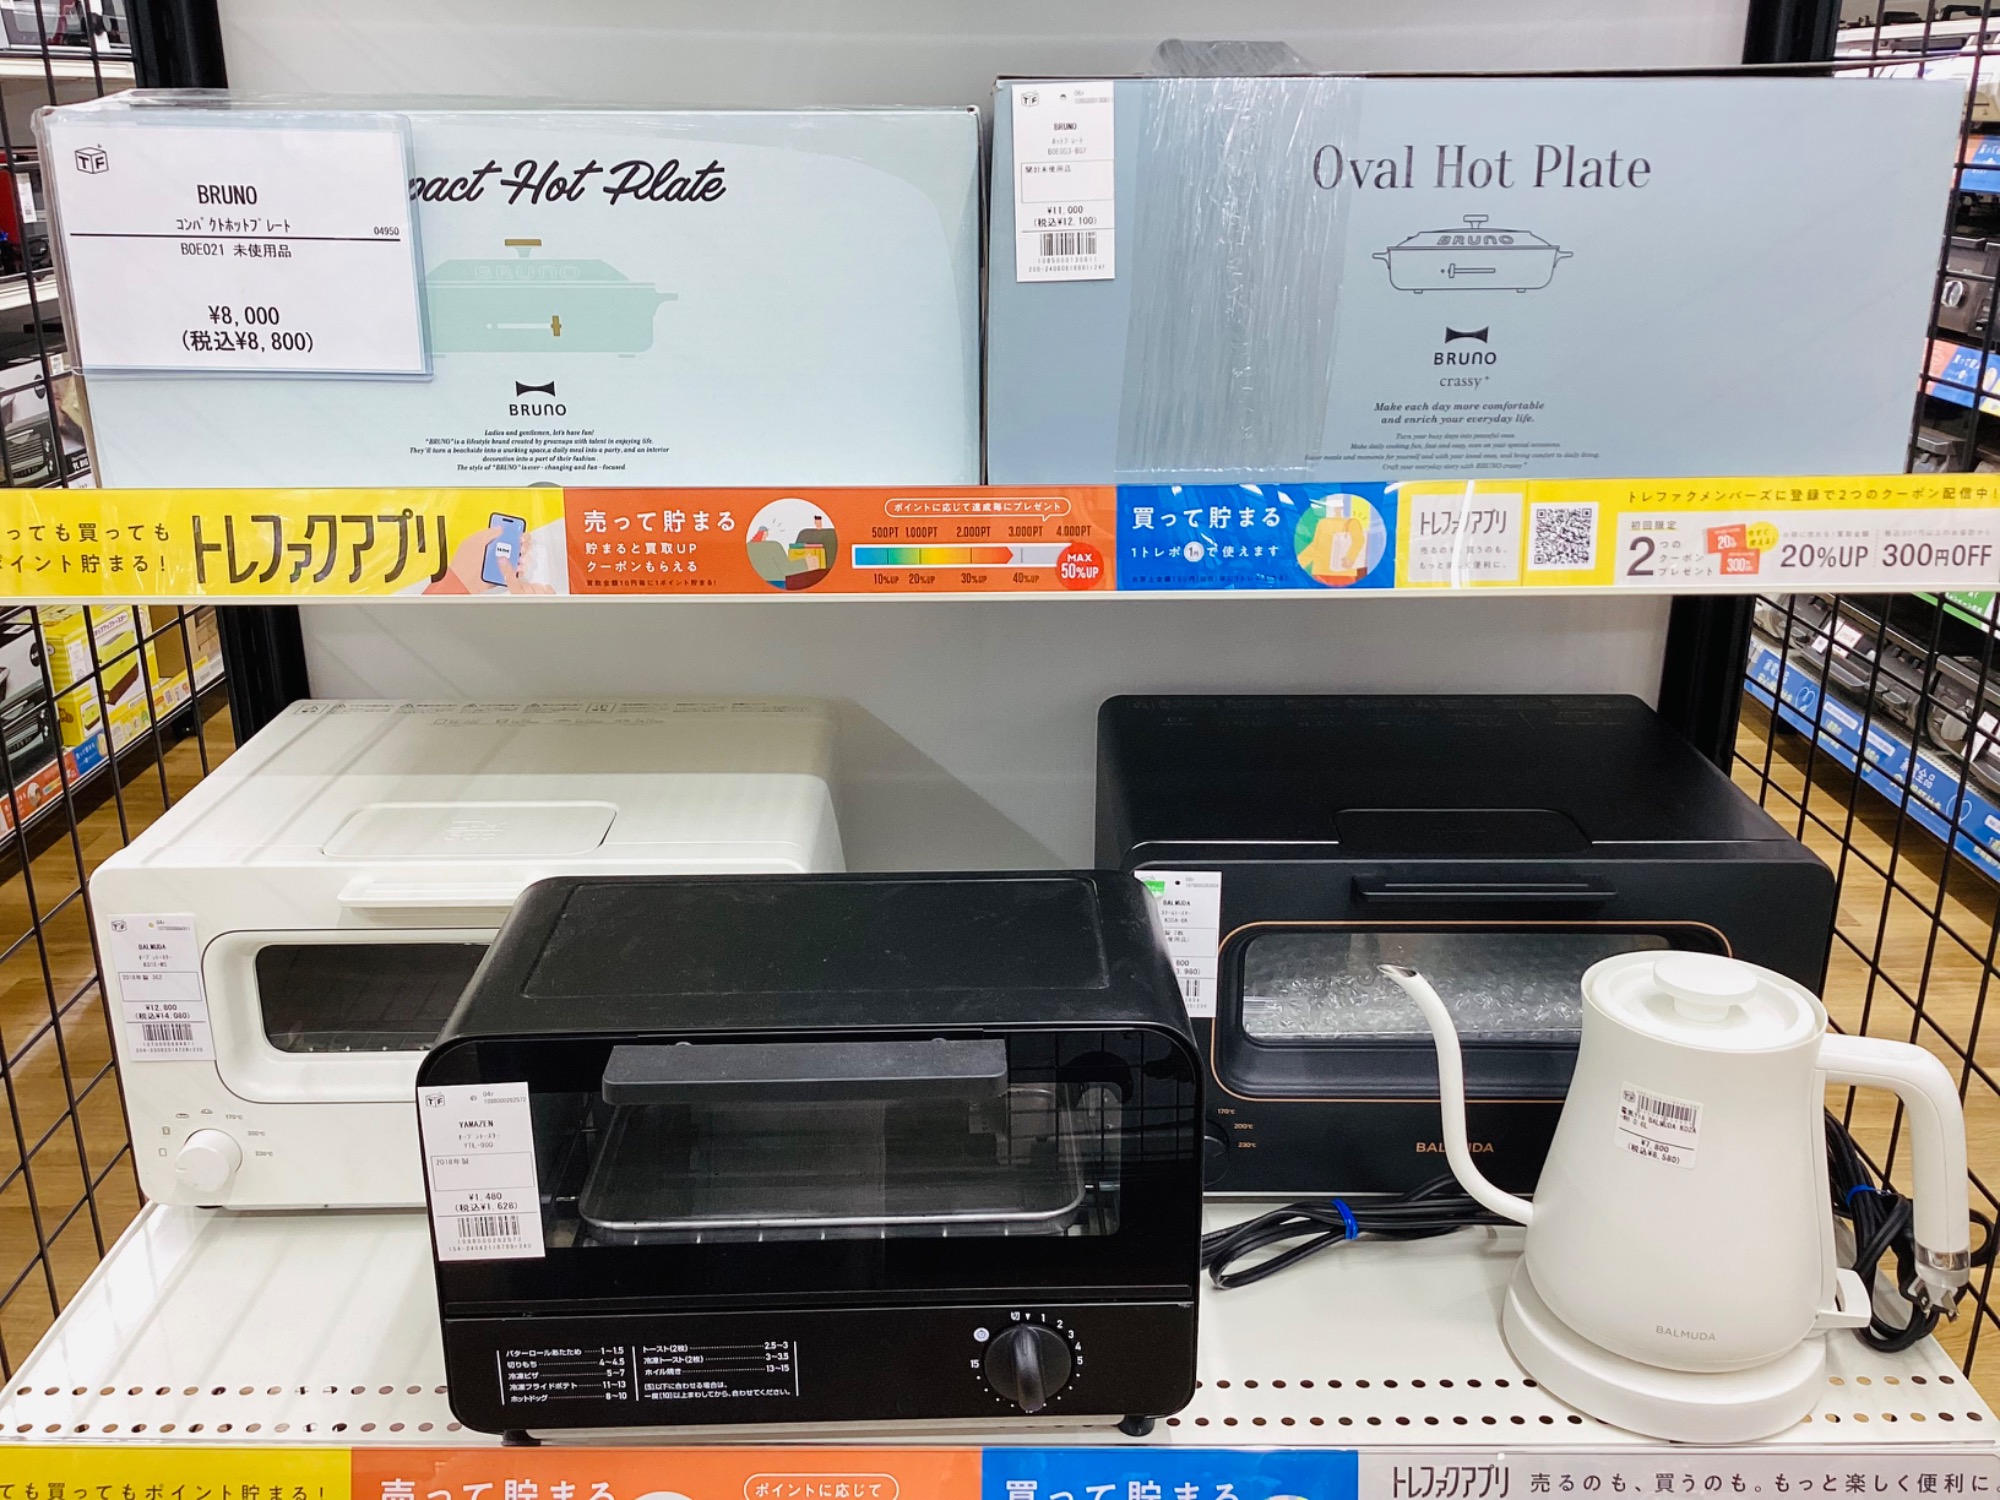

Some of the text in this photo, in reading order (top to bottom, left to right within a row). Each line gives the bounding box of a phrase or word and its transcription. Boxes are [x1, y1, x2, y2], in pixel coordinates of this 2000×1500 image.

[1313, 144, 1652, 190] Oval Hot Plate
[500, 159, 603, 205] Hot
[603, 159, 727, 206] Plate
[197, 184, 257, 205] BRUNO
[373, 226, 400, 236] 04950
[1436, 235, 1514, 246] BRUNO
[233, 243, 292, 259] 未使用品
[209, 305, 280, 326] ¥8,000
[182, 330, 314, 352] (税込¥8,800)
[1433, 351, 1497, 366] BRUNO
[509, 404, 567, 416] BRUNO
[1374, 400, 1544, 413] Make each day more comfortable
[1381, 415, 1401, 424] and
[1404, 415, 1437, 424] enrich
[1439, 416, 1463, 425] your
[1467, 415, 1512, 425] everyday
[584, 509, 736, 533] 売って貯まる
[1132, 506, 1280, 530] 買って貯まる
[1631, 520, 1677, 530] 初回限定
[7, 522, 169, 542] っても買っても
[872, 526, 899, 538] 500PT
[192, 508, 448, 584] トレファクアプリ
[585, 542, 697, 555] 貯まると買取UP
[1659, 540, 1681, 549] つの
[1066, 553, 1093, 563] MAX
[1659, 553, 1705, 564] クーポン
[1780, 544, 1868, 568] 20%UP
[1882, 543, 1992, 567] 300円OFF
[586, 560, 697, 572] クーポンもらえる
[1061, 564, 1099, 579] 50%UP
[1659, 567, 1713, 578] プレゼント
[1415, 1141, 1495, 1153] BALDA
[1041, 1313, 1046, 1322] 1
[1057, 1320, 1063, 1329] 2
[1068, 1330, 1074, 1339] 3
[1656, 1325, 1716, 1341] BALMUDA
[1075, 1342, 1081, 1350] 4
[970, 1359, 980, 1368] 15
[1077, 1356, 1083, 1365] 5
[1393, 1463, 1510, 1498] トレファクアプリ
[755, 1482, 882, 1498] ポイントに応じて
